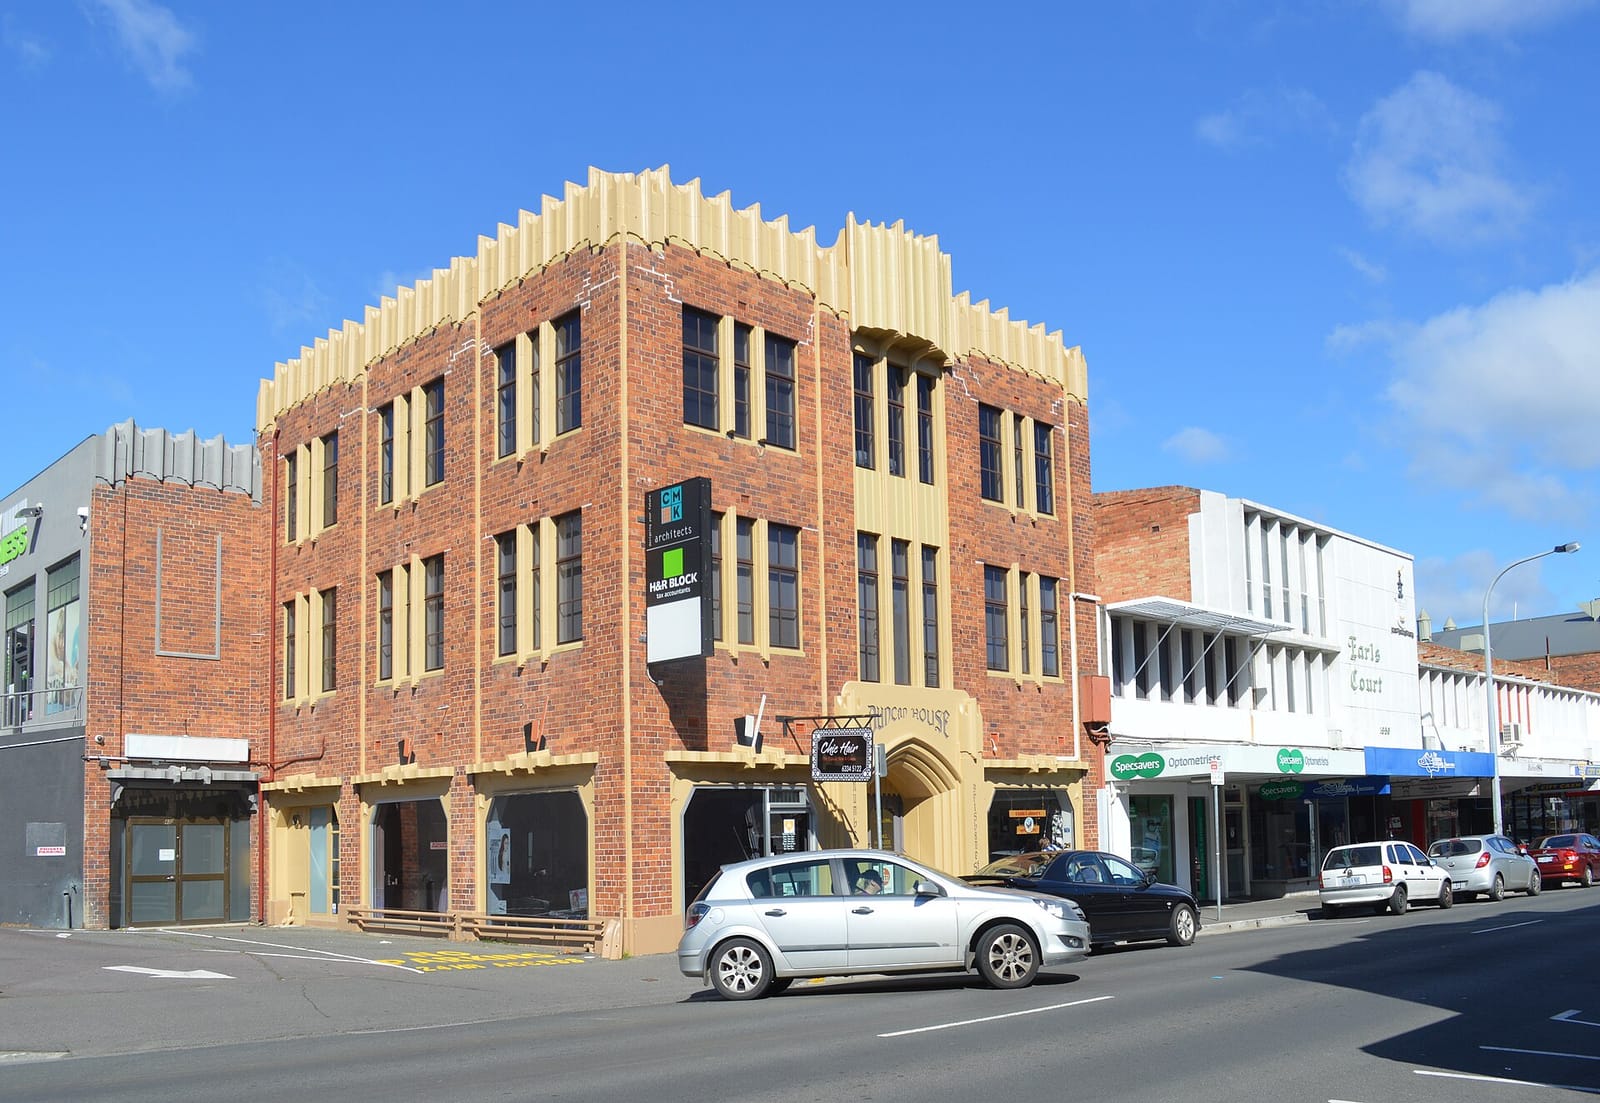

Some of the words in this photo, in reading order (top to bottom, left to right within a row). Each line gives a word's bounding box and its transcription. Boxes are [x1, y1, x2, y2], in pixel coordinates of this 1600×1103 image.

[654, 526, 692, 543] architects
[649, 579, 668, 593] H&R
[668, 572, 698, 588] BLOCK
[664, 587, 691, 598] accountants
[1347, 635, 1381, 663] Earls
[1350, 669, 1383, 694] Court
[910, 707, 950, 738] HOUSE
[820, 738, 839, 756] Chic
[839, 741, 859, 756] Hair
[1115, 759, 1160, 773] Specsavers
[1279, 754, 1303, 766] Specsavers
[1304, 756, 1329, 767] Optometrists
[1260, 785, 1297, 796] Specsavers
